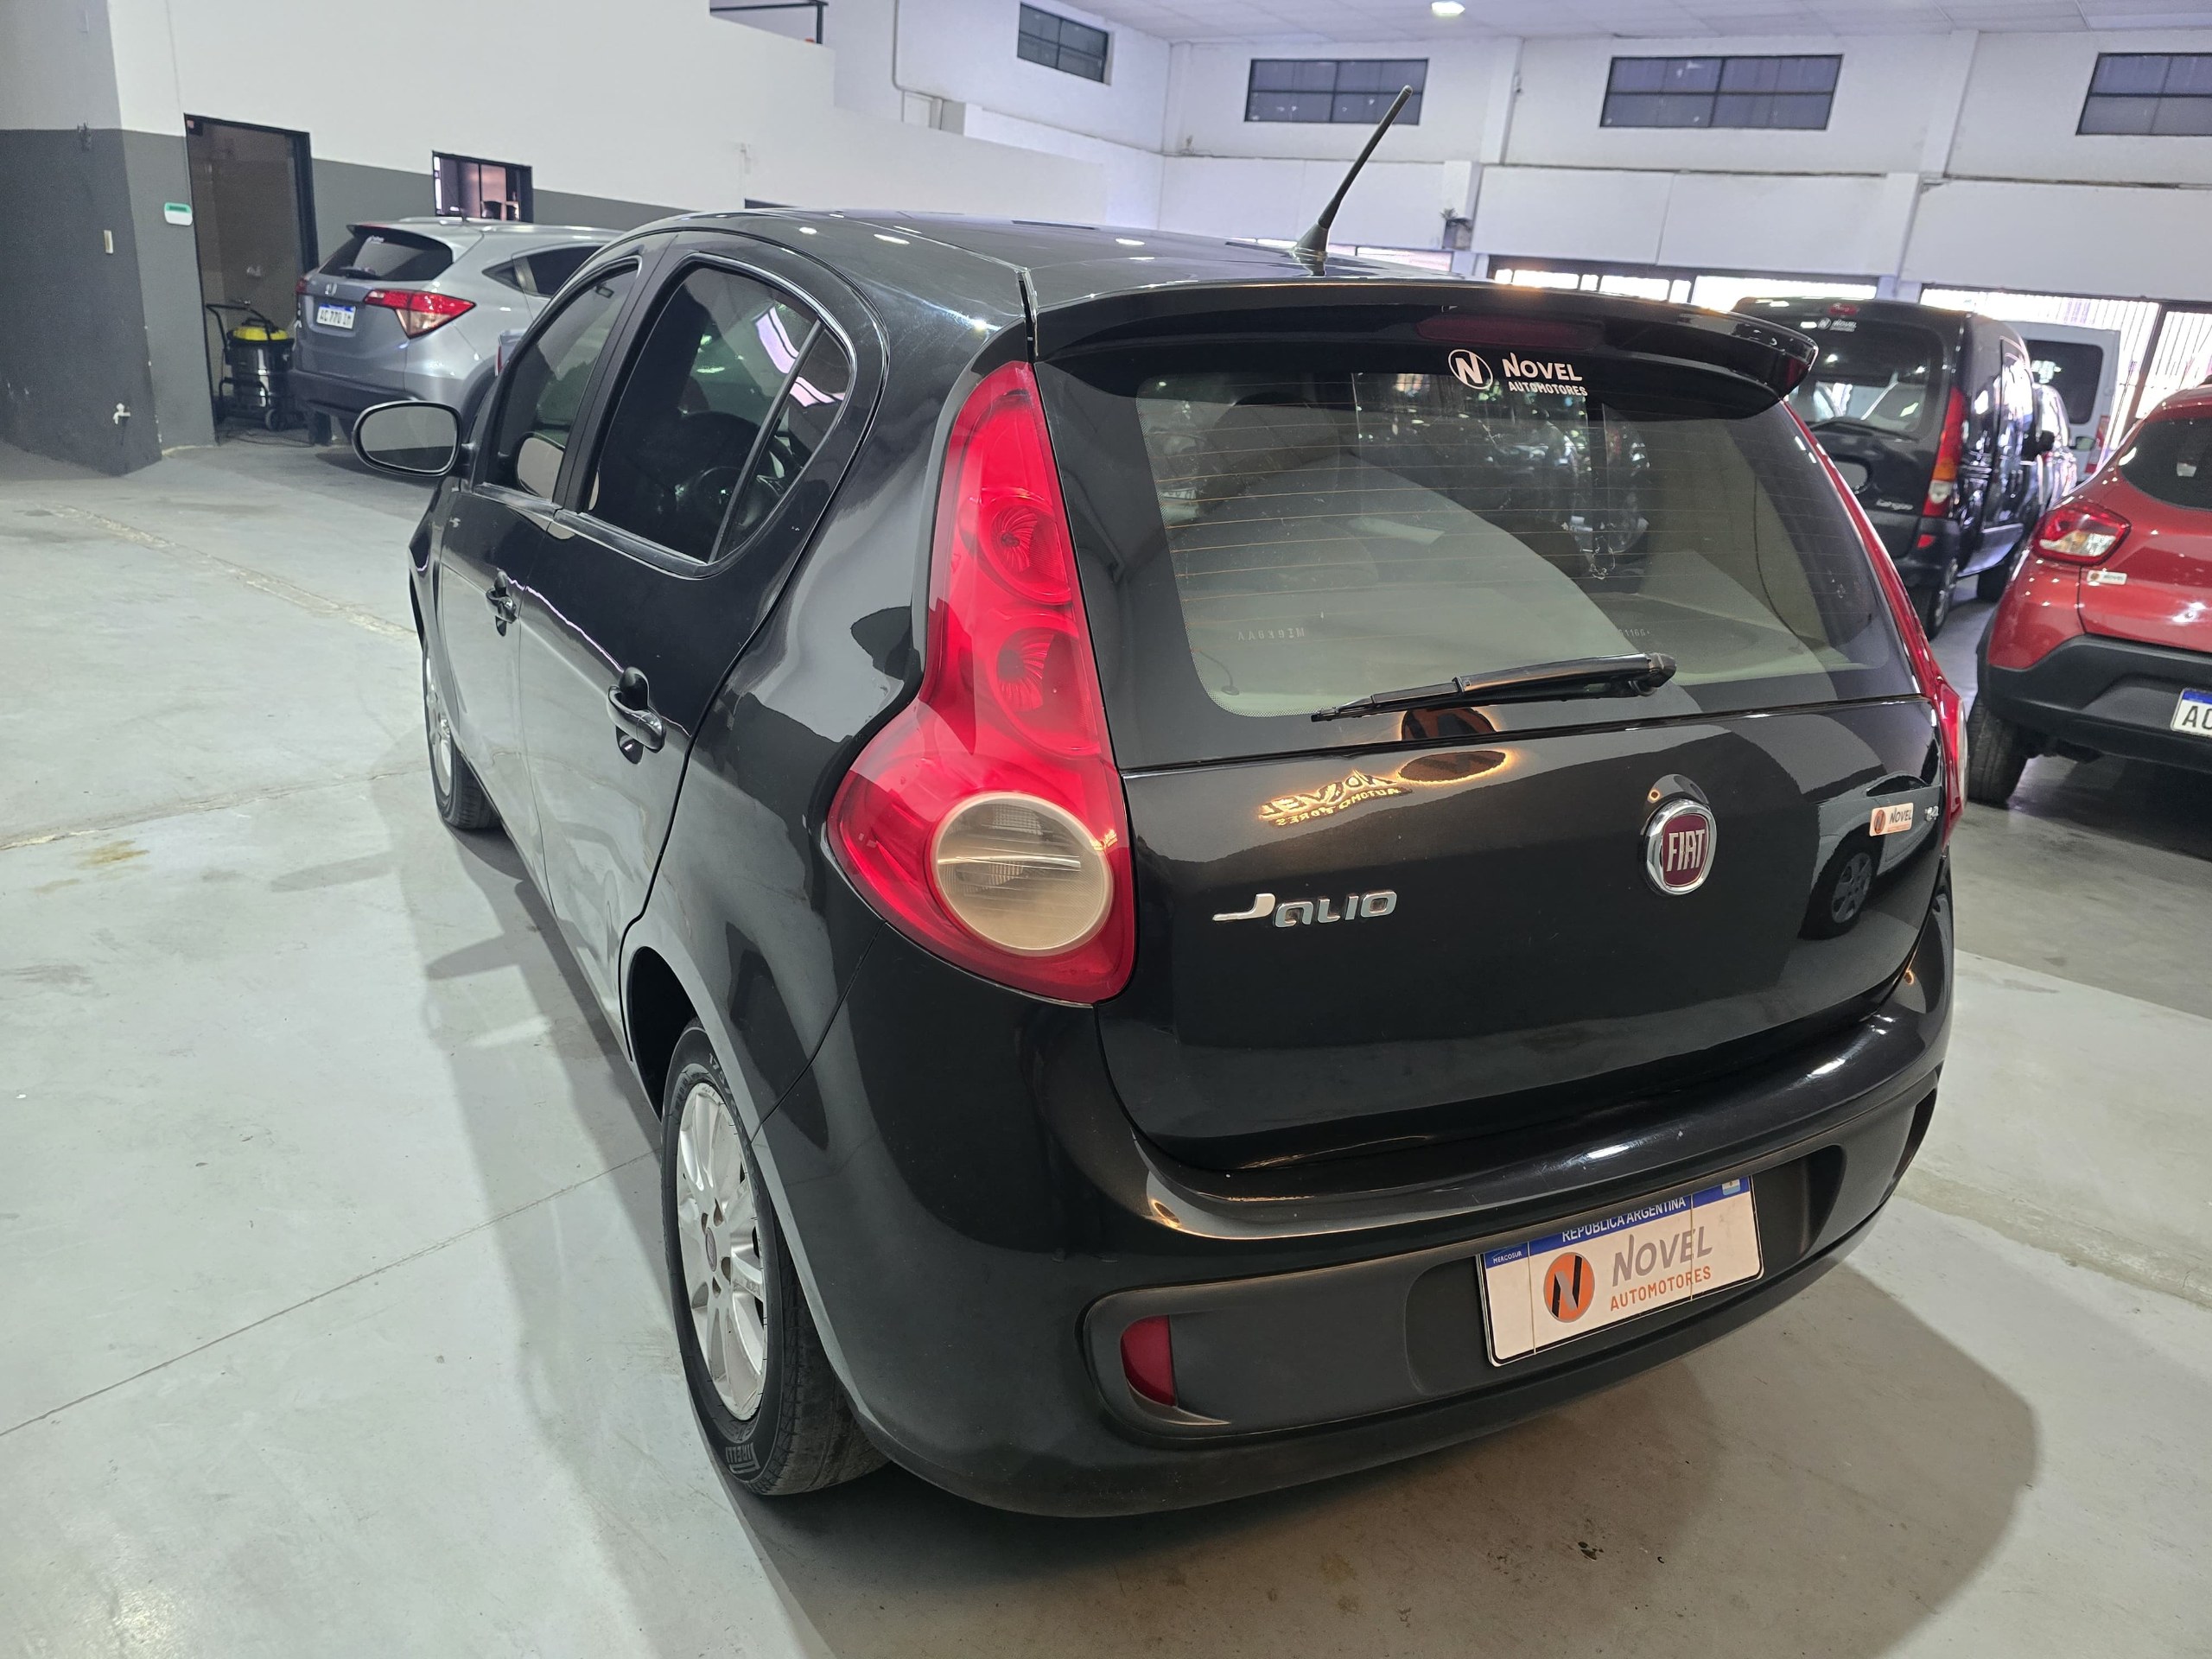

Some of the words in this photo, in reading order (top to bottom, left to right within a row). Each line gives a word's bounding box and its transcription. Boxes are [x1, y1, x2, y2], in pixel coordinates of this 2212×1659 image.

[1502, 352, 1583, 381] NOVEL
[1508, 381, 1588, 397] AUTOMOTORES
[1890, 807, 1912, 824] NOVEL
[1666, 829, 1706, 872] FIAT
[1626, 1197, 1687, 1224] ARGENTINA
[1493, 1250, 1522, 1264] MERCOSUR
[1611, 1226, 1713, 1287] NOVEL
[1610, 1267, 1712, 1312] AUTOMOTORES
[726, 1442, 760, 1474] PIRELLI
